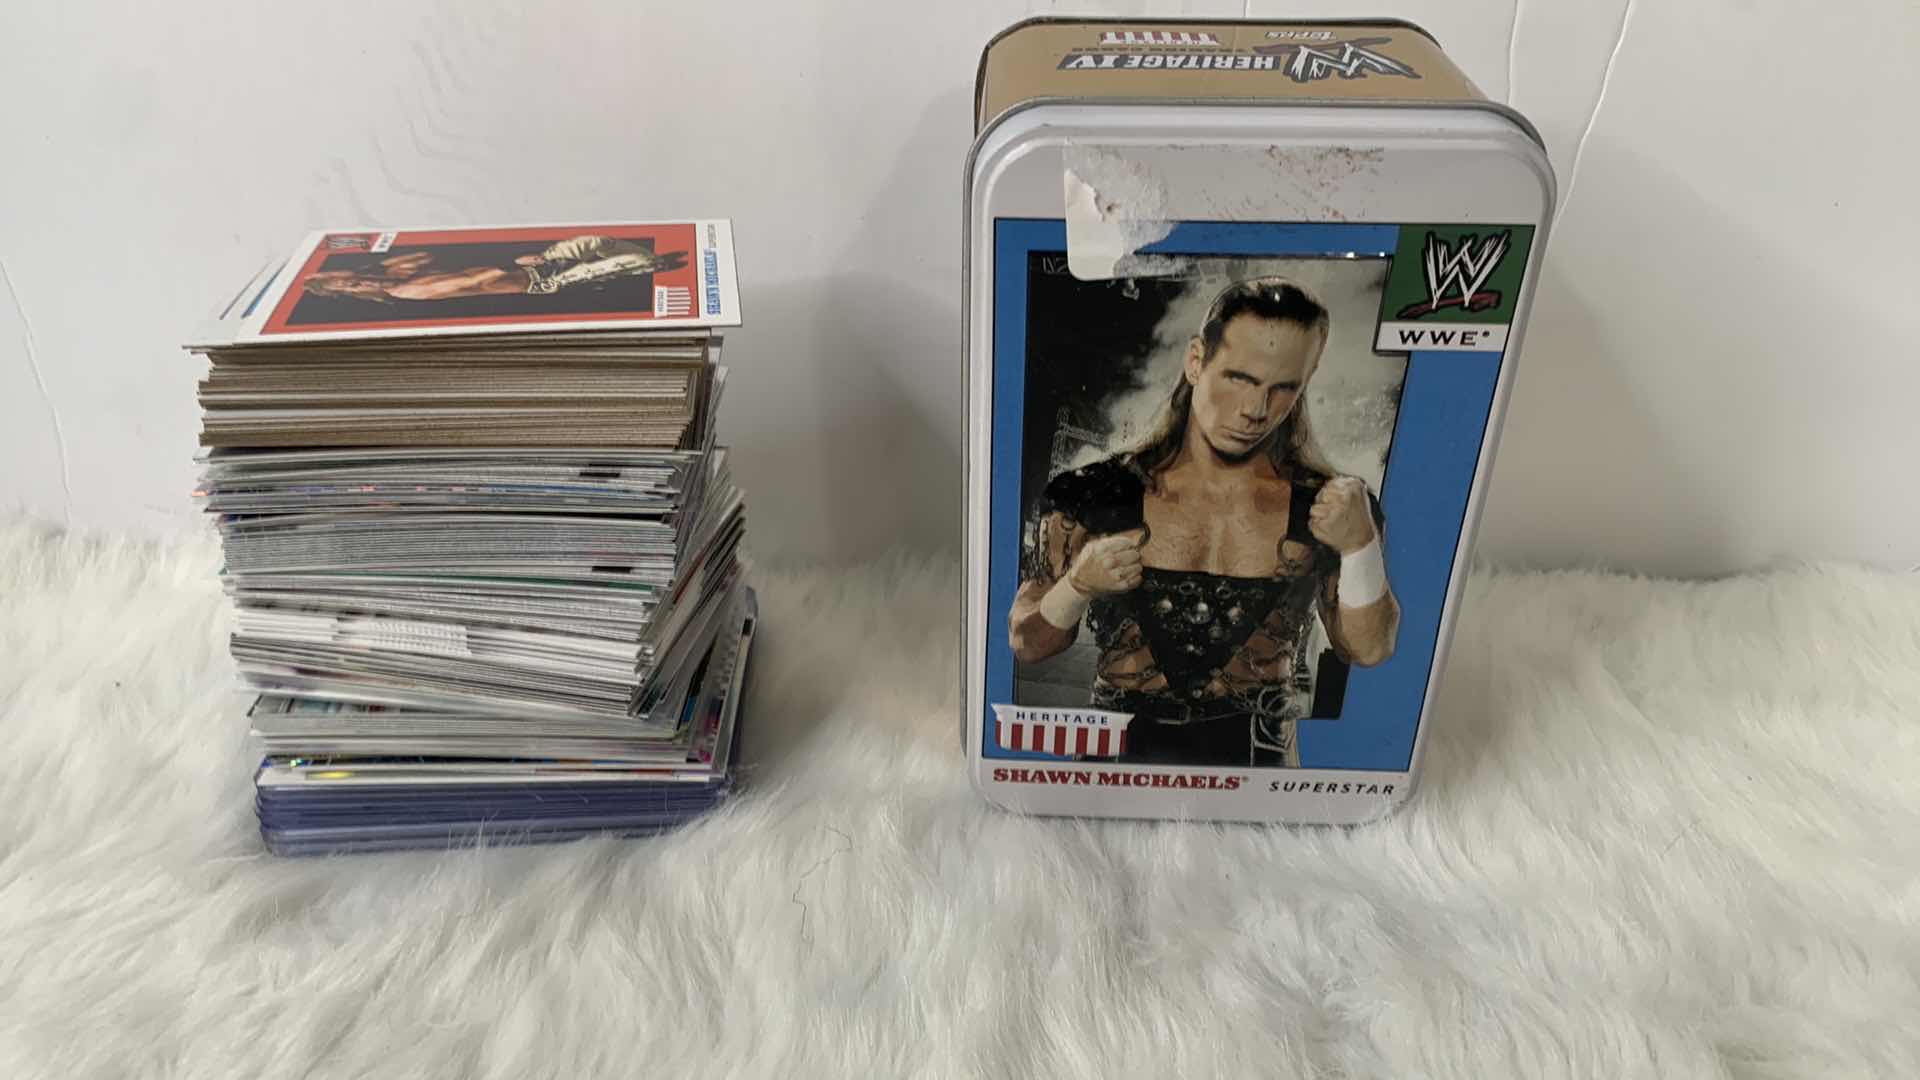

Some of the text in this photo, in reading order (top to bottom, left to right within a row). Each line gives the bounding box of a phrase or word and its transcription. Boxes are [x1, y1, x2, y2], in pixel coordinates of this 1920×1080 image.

[1064, 54, 1276, 70] HERITAGE IV
[1015, 711, 1109, 726] HERITAGE
[993, 767, 1092, 786] SHAWN
[1268, 780, 1395, 795] SUPERSTAR
